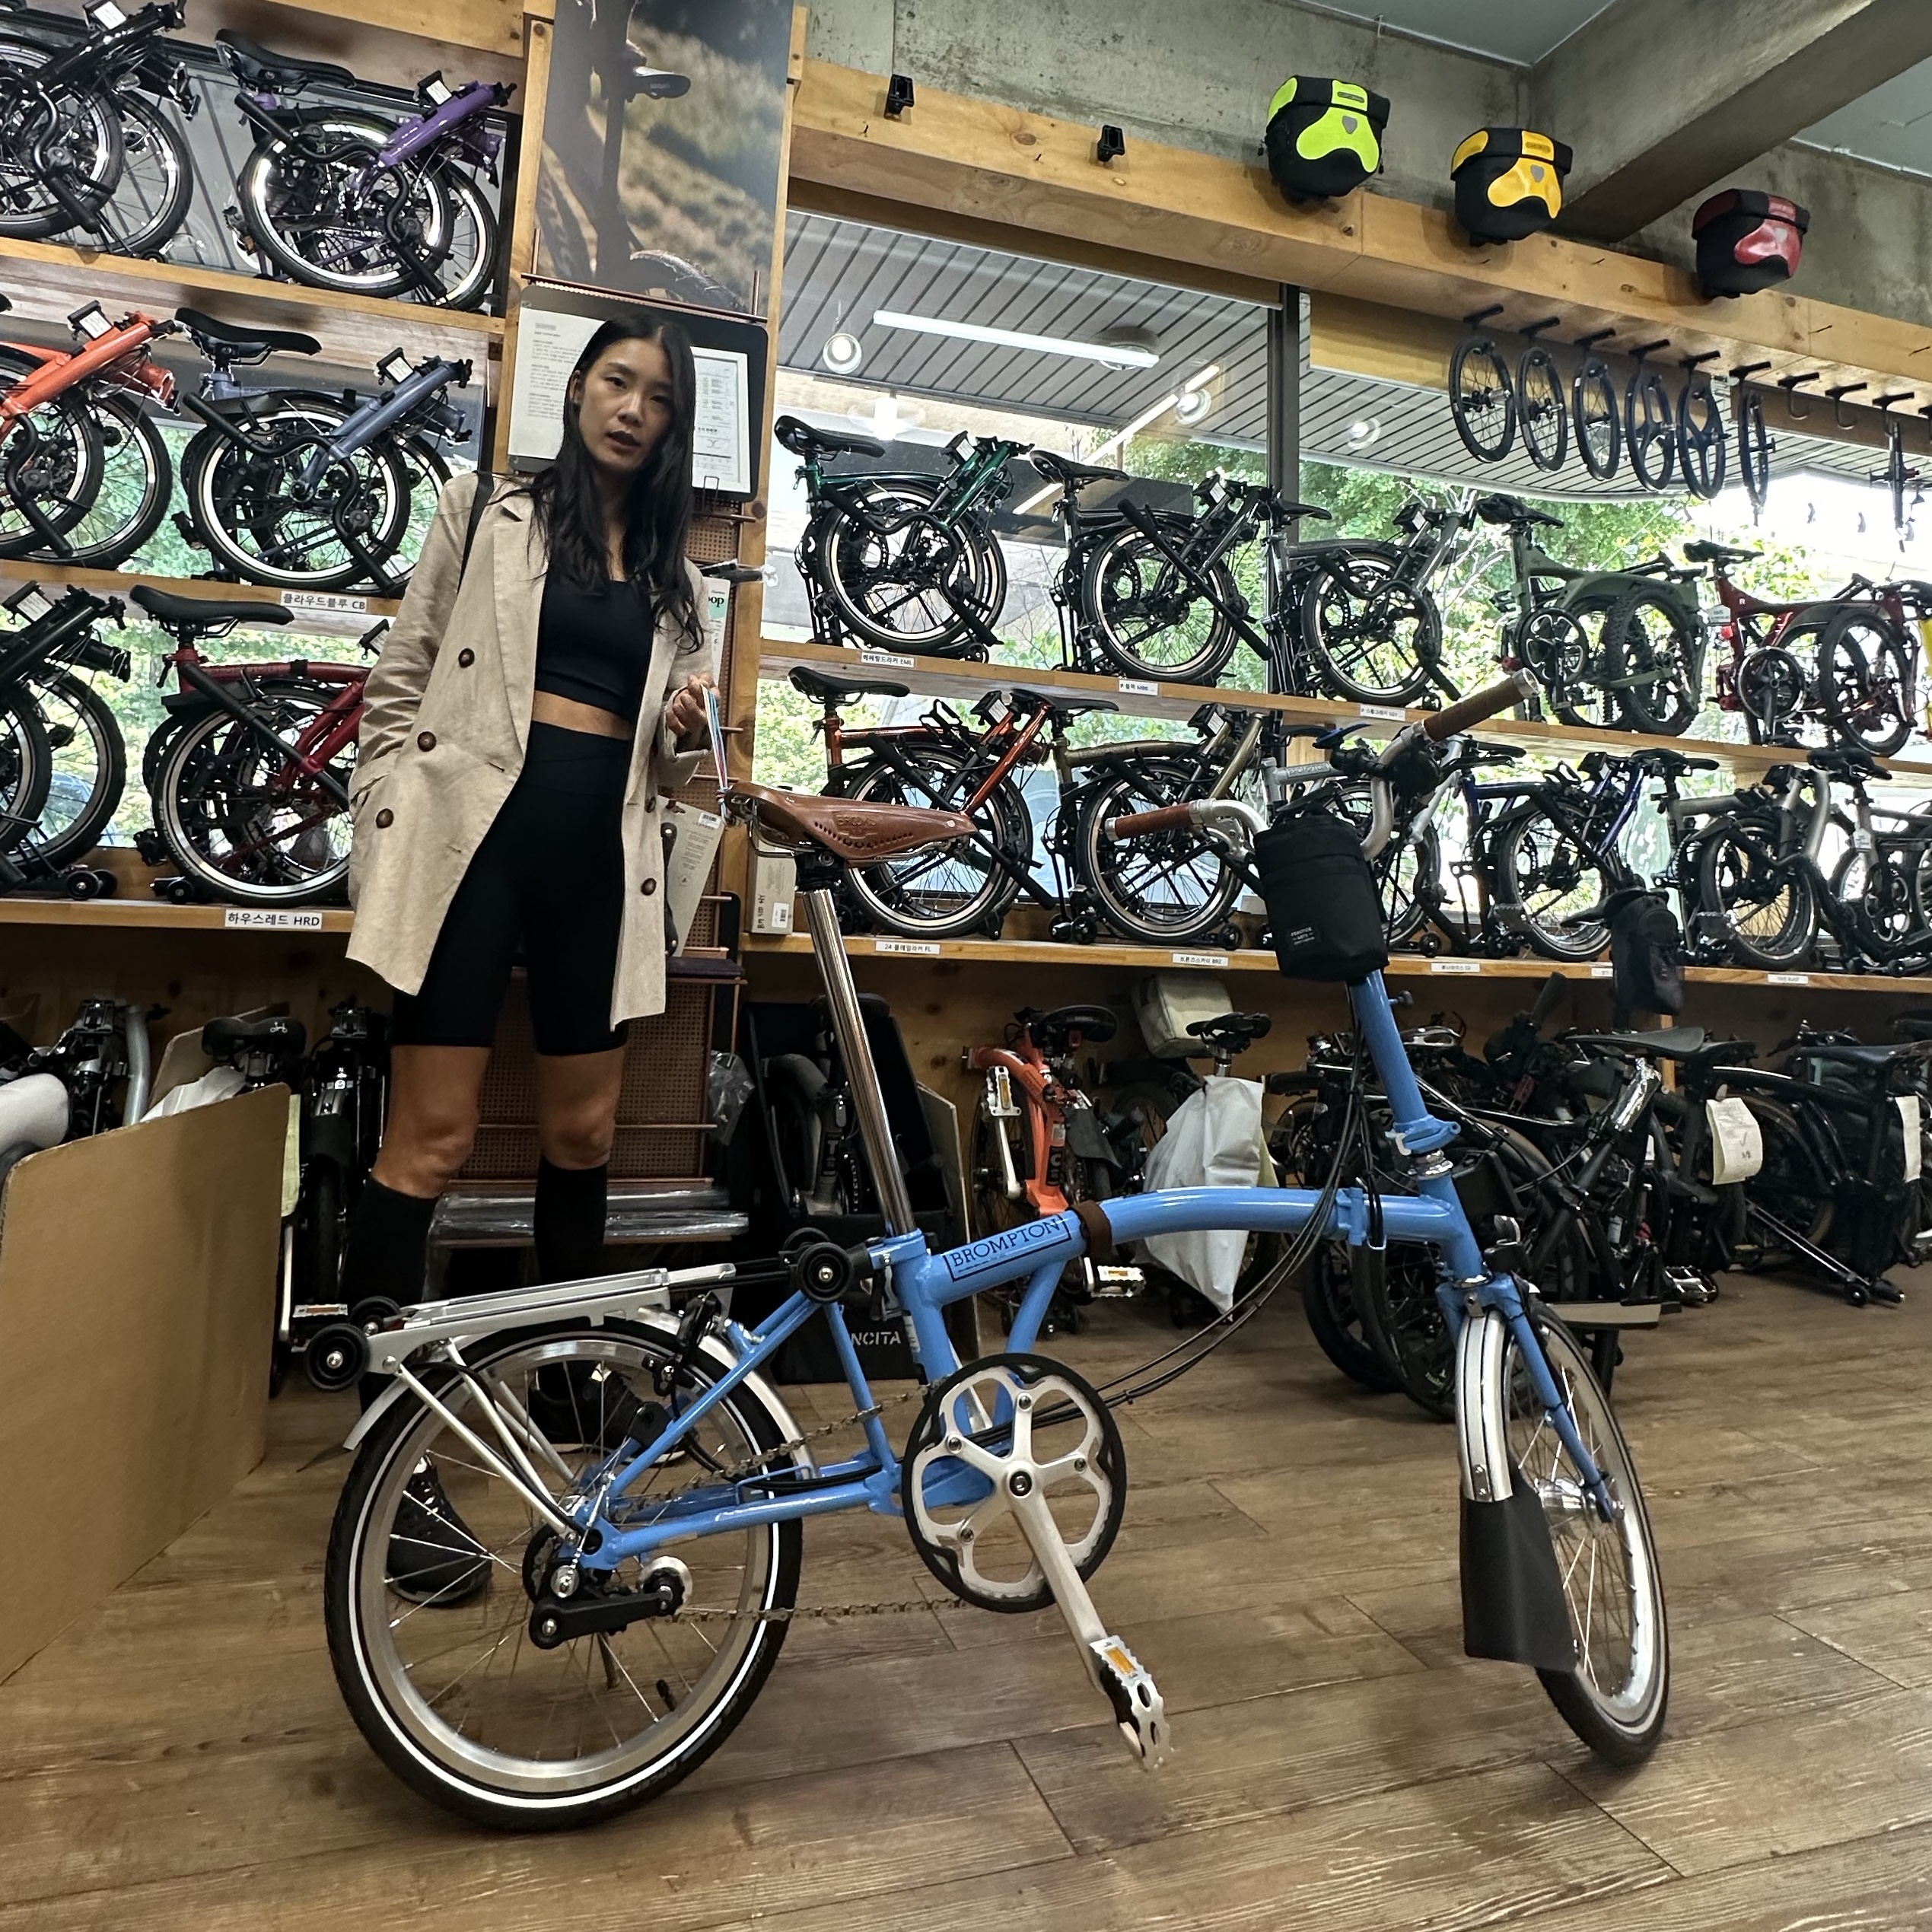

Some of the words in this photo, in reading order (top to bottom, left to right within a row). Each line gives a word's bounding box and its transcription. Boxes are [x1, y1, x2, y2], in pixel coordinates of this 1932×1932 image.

[284, 594, 348, 608] 클라우드블루
[352, 601, 365, 610] CB
[228, 912, 288, 925] 하우스레드
[294, 915, 320, 926] HRD
[950, 1218, 1061, 1267] BROMPTON
[851, 1331, 901, 1345] NCITA
